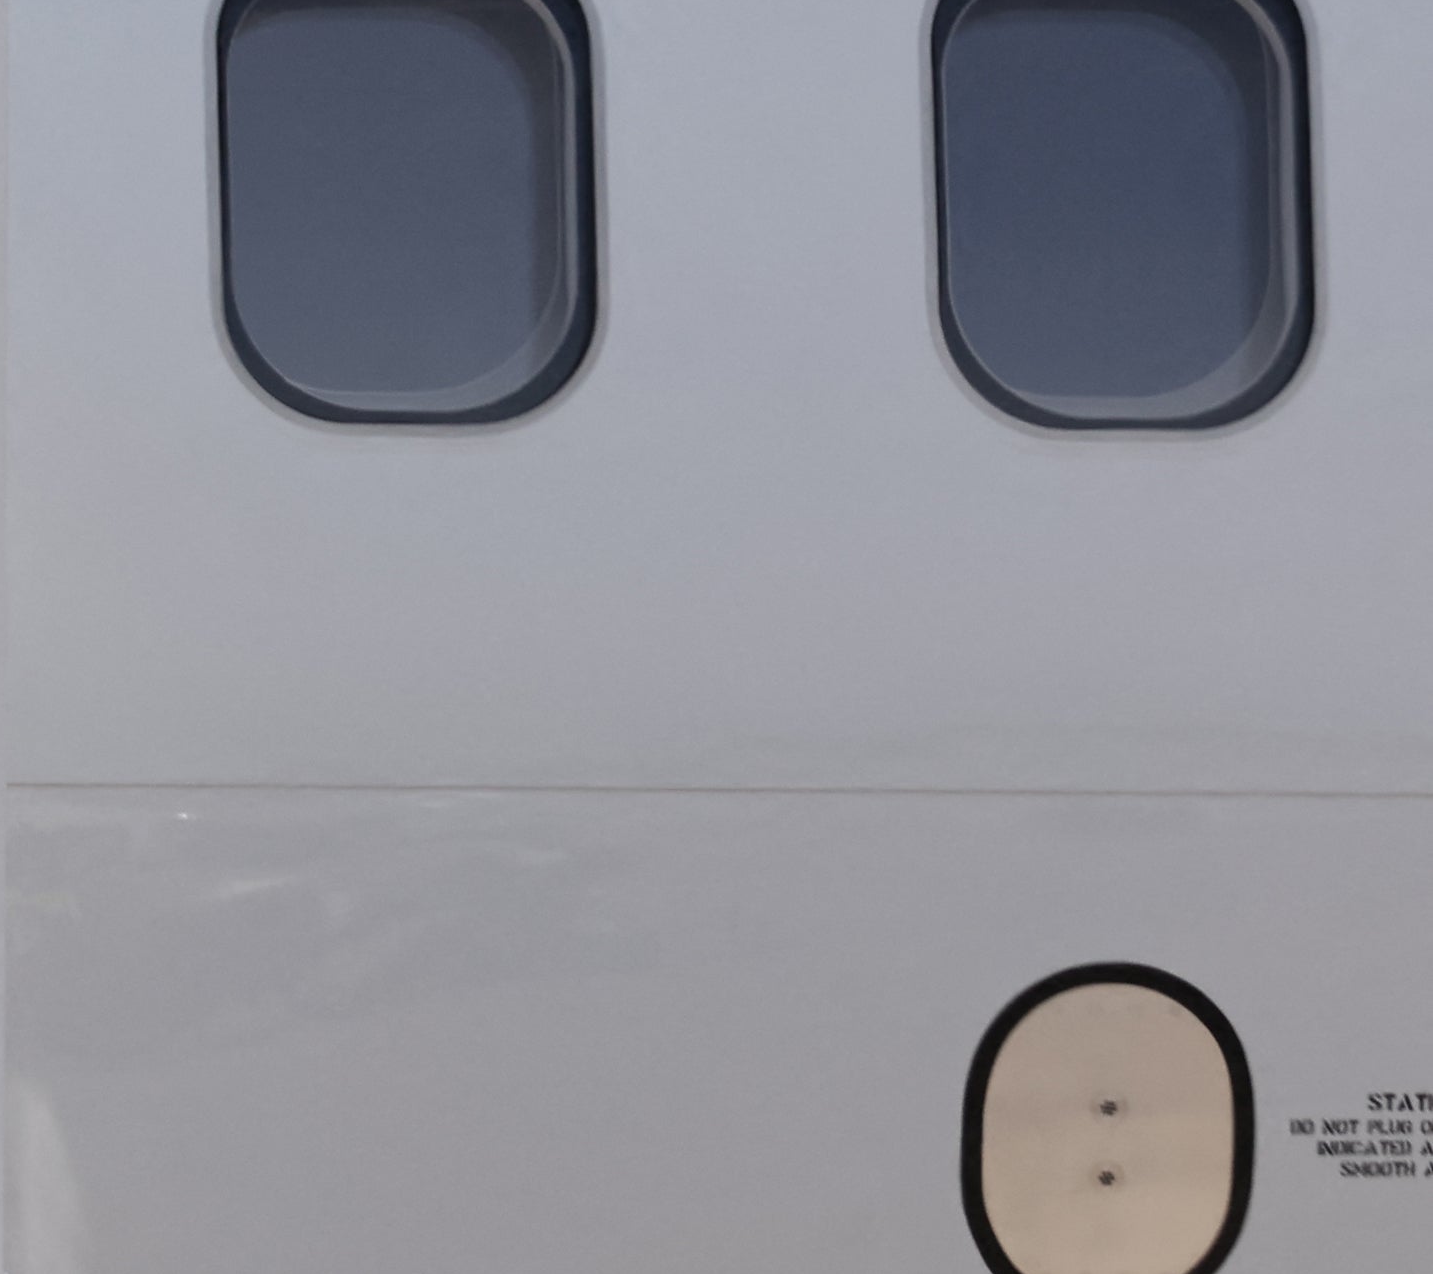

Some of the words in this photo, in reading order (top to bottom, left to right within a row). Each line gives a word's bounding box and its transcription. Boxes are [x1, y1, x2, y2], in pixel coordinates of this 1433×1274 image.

[1321, 1118, 1359, 1135] NOT
[1366, 1119, 1413, 1135] PLUG
[1317, 1139, 1413, 1156] INDICATED
[1339, 1160, 1416, 1178] SMOOTH
